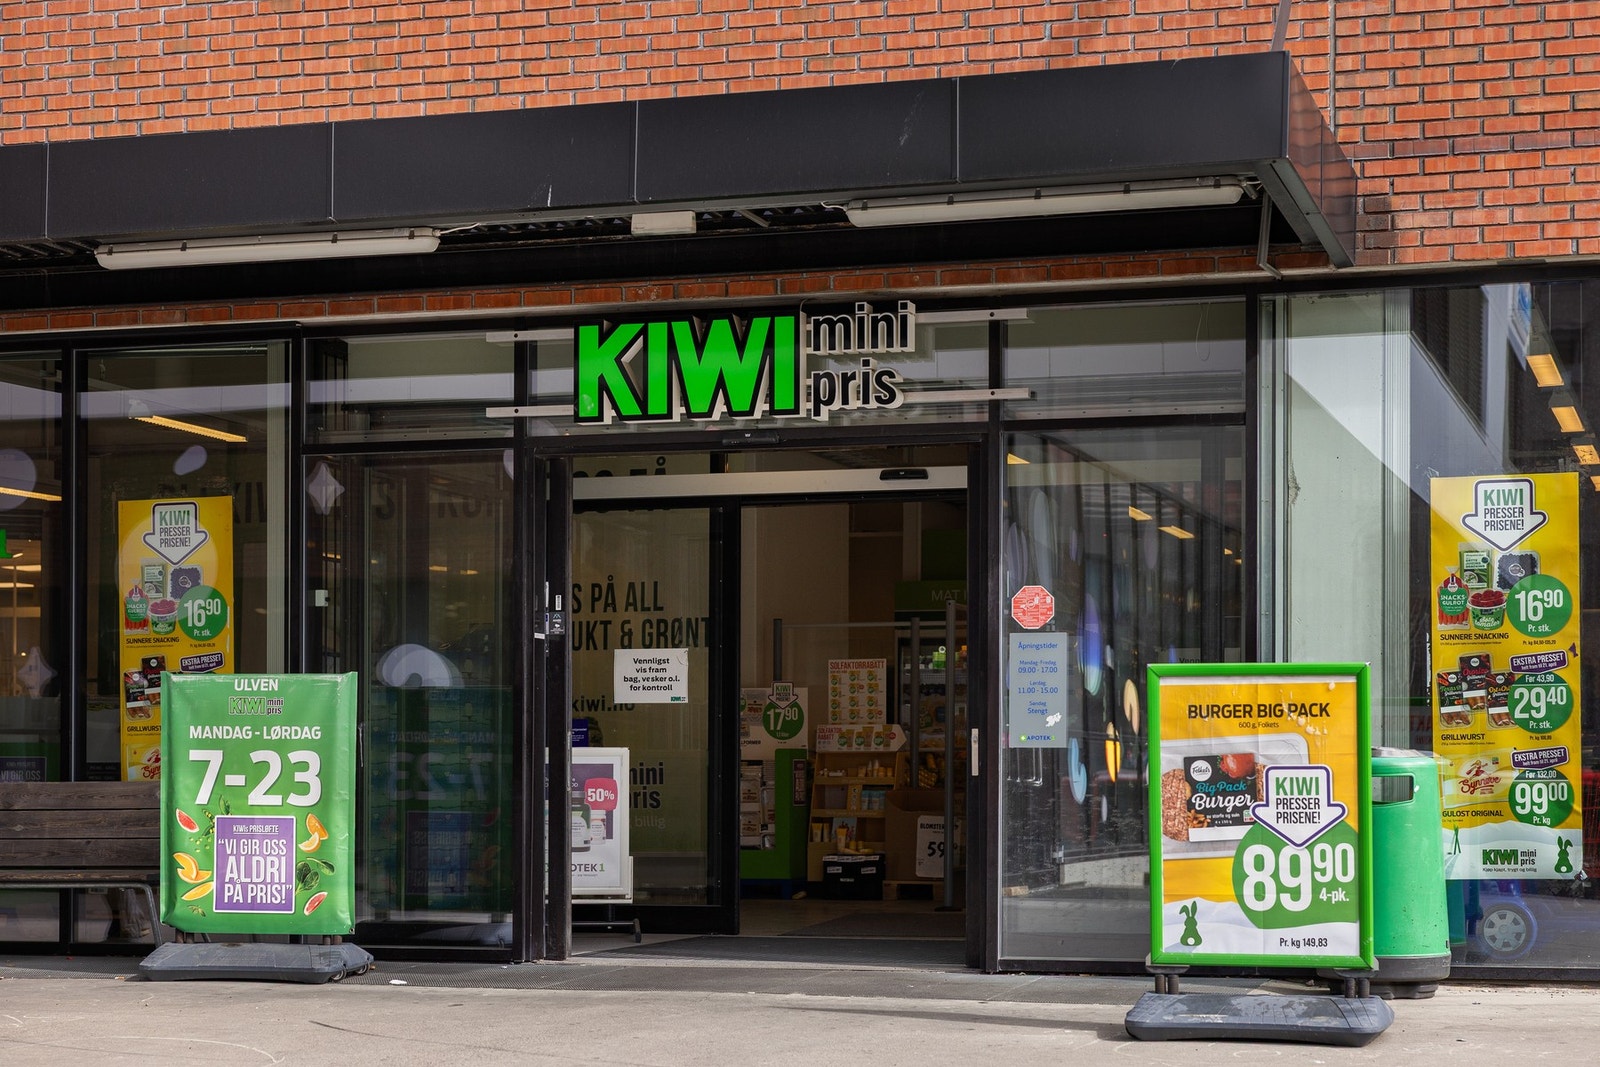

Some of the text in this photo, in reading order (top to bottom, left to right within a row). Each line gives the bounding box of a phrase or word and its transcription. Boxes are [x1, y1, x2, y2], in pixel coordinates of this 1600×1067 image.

[811, 301, 914, 352] mini
[574, 312, 801, 423] KIWI
[811, 358, 902, 421] pris
[1484, 488, 1524, 507] KIWI
[159, 510, 190, 526] KIWI
[1484, 507, 1524, 519] PRESSER
[160, 526, 190, 538] PRESSER
[1484, 519, 1524, 532] PRISENE!
[160, 537, 191, 548] PRISENE!
[590, 574, 617, 614] PÅ
[624, 581, 664, 612] ALL
[1528, 623, 1552, 632] Pr. stk.
[572, 620, 612, 651] UKT
[620, 619, 634, 650] &
[1440, 632, 1510, 641] SUNNERE SNACKING
[1018, 641, 1058, 650] Åpningstider
[182, 656, 200, 667] EKSTRA
[201, 654, 221, 664] PRESSET
[830, 661, 884, 670] SOLFAKTORRABATT
[1513, 652, 1564, 666] EKSTRA PRESSET
[234, 678, 278, 692] ULVEN
[623, 675, 641, 683] bag,
[229, 696, 266, 715] KIWI
[266, 697, 284, 706] mini
[266, 706, 282, 715] pris
[1188, 702, 1330, 719] BURGER BIG PACK
[189, 725, 252, 739] MANDAG
[263, 725, 322, 740] LØRDAG
[1514, 749, 1565, 762] EKSTRA PRESSET
[189, 750, 322, 806] 7-23
[629, 762, 664, 785] ini
[1196, 780, 1247, 795] Big Pack
[1275, 776, 1320, 796] KIWI
[587, 788, 615, 802] 50%
[629, 786, 662, 809] ris
[1191, 793, 1254, 812] Burger
[1276, 797, 1320, 810] PRESSER
[1276, 811, 1321, 824] PRISENE!
[1532, 816, 1550, 825] Pr. kg
[249, 825, 279, 833] PRISLØFTE
[240, 839, 260, 855] GIR
[264, 838, 287, 856] OSS
[1482, 849, 1519, 865] KIWI
[1520, 857, 1535, 866] pris
[224, 856, 286, 883] ALDRI
[572, 864, 598, 872] OTEK
[224, 878, 243, 904] PÅ
[1319, 888, 1349, 904] 4-pk.
[1280, 938, 1289, 947] Pr.
[1291, 938, 1300, 949] kg
